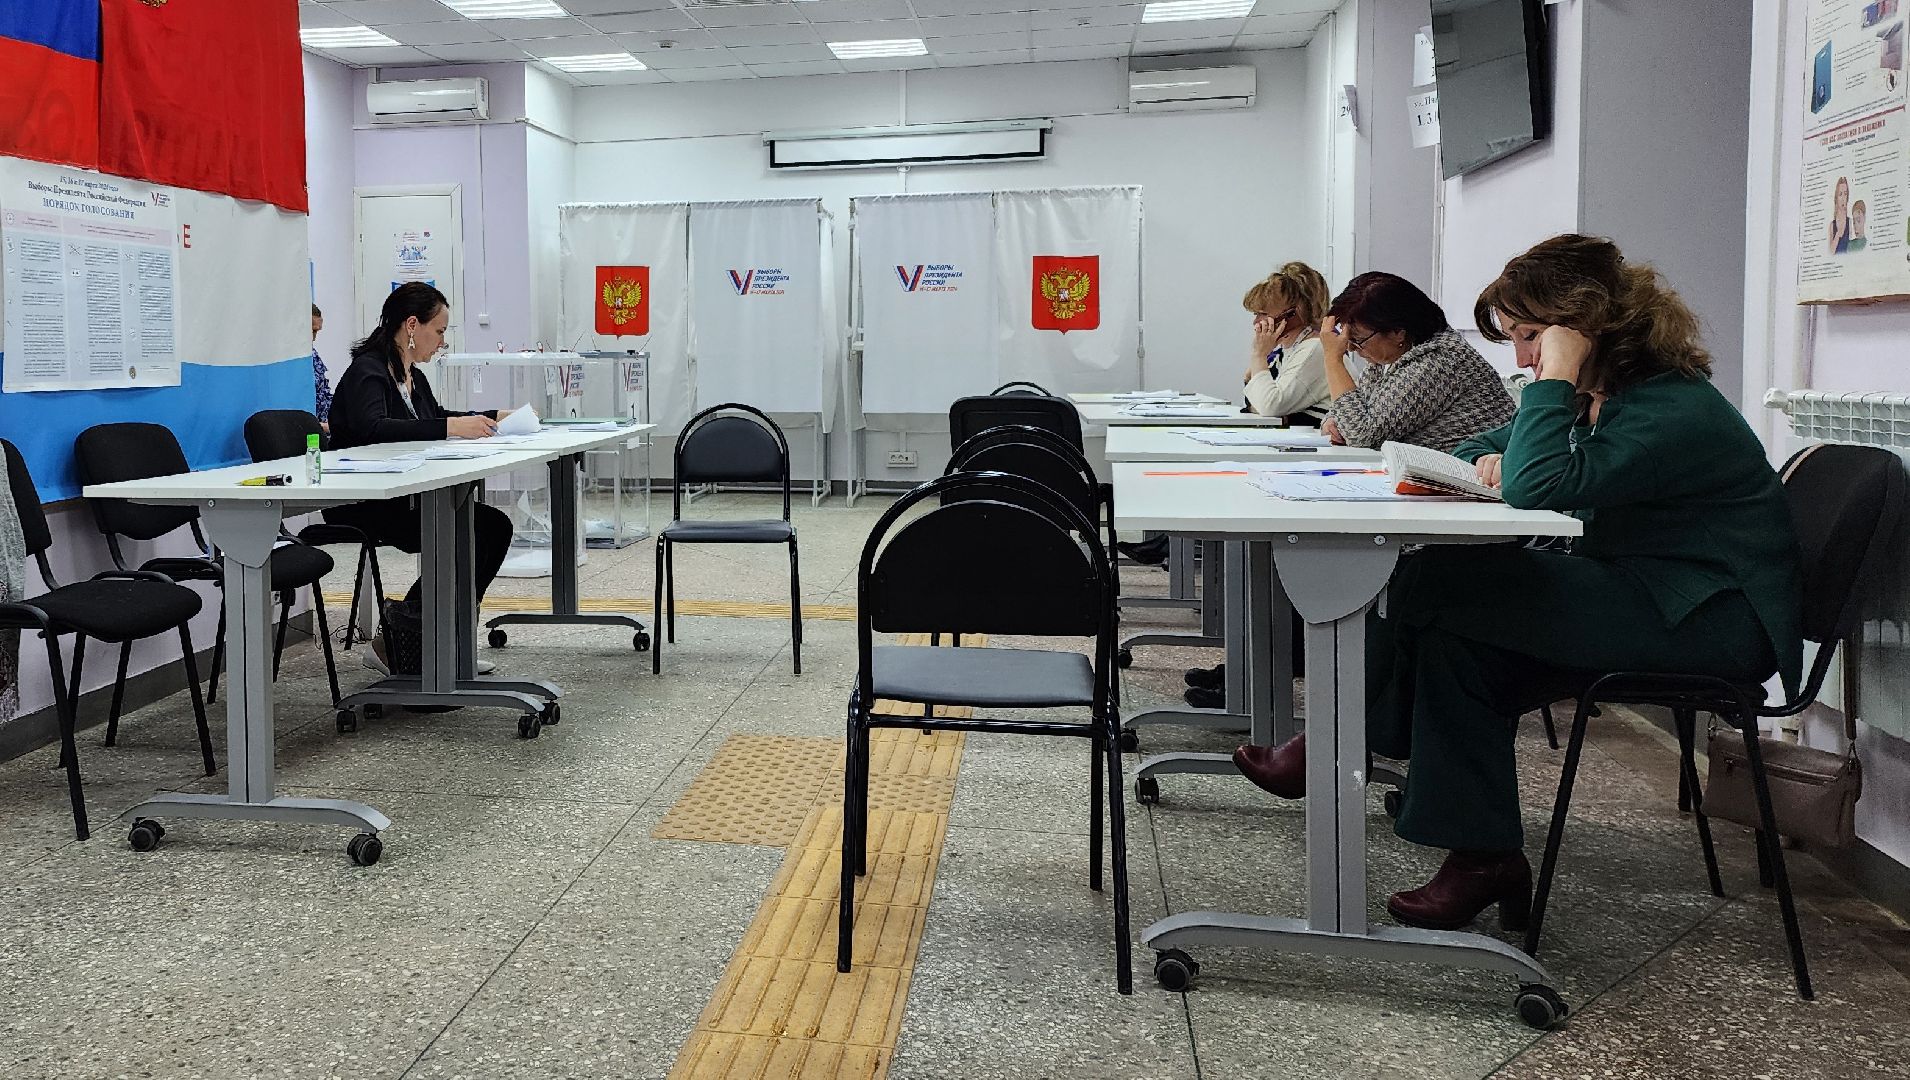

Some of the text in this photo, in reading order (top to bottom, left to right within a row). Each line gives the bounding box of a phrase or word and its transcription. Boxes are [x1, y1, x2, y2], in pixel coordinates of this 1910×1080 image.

[42, 197, 135, 220] ПОРЯДОК ГОЛОСОВАНИЯ
[756, 268, 783, 276] ВЫБОРЫ
